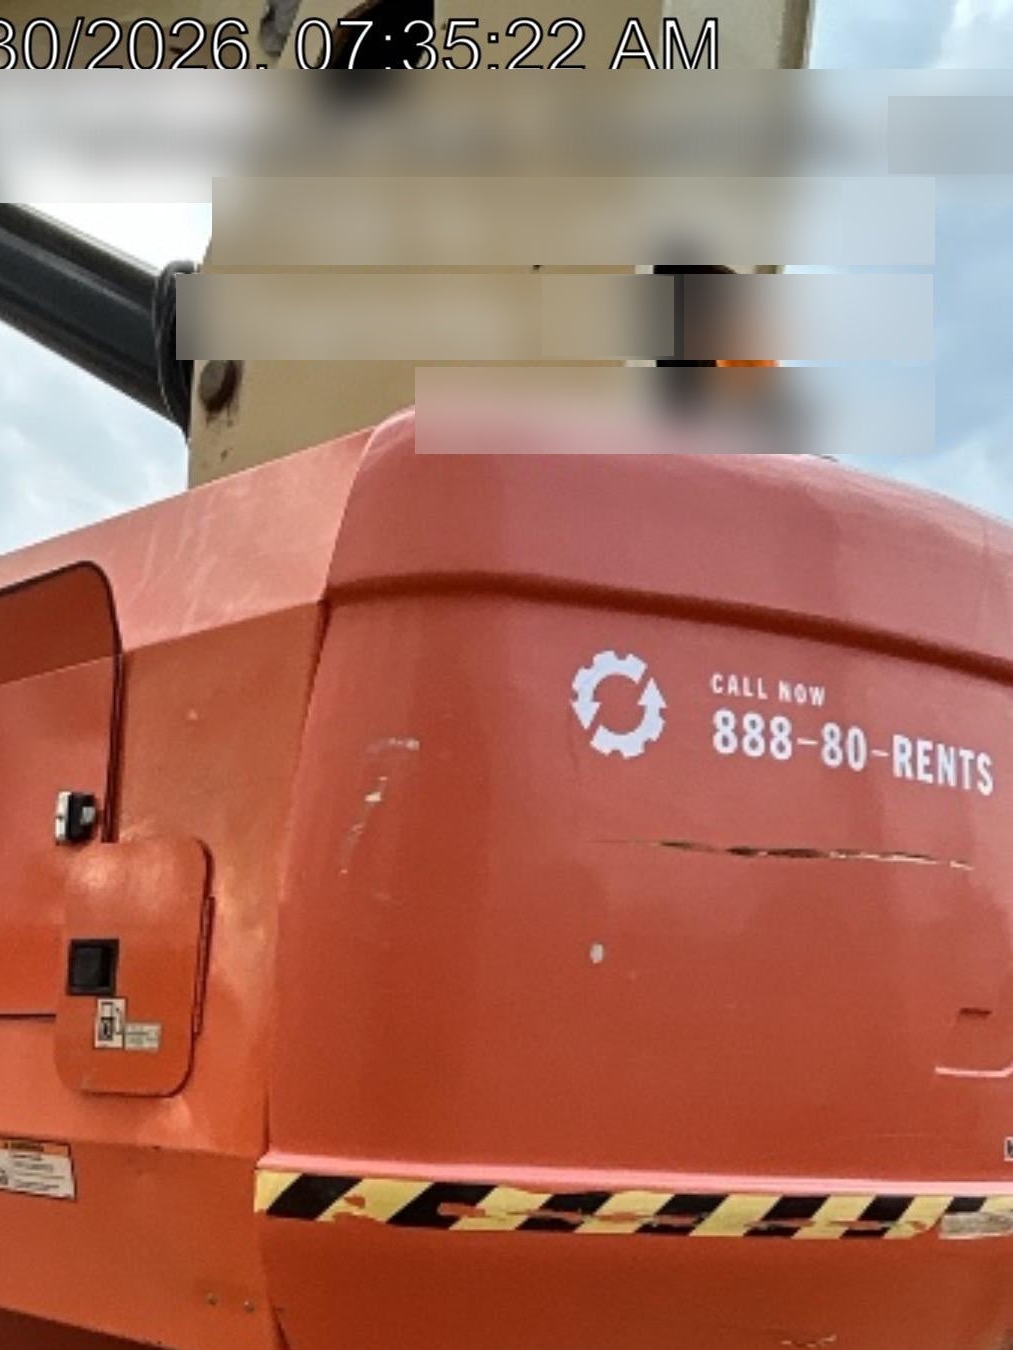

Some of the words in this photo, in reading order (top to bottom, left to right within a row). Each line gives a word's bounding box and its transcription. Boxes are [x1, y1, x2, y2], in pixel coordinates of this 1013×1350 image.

[710, 673, 768, 700] CALL
[778, 680, 826, 707] NOW
[712, 709, 994, 796] 888-80-RENTS
